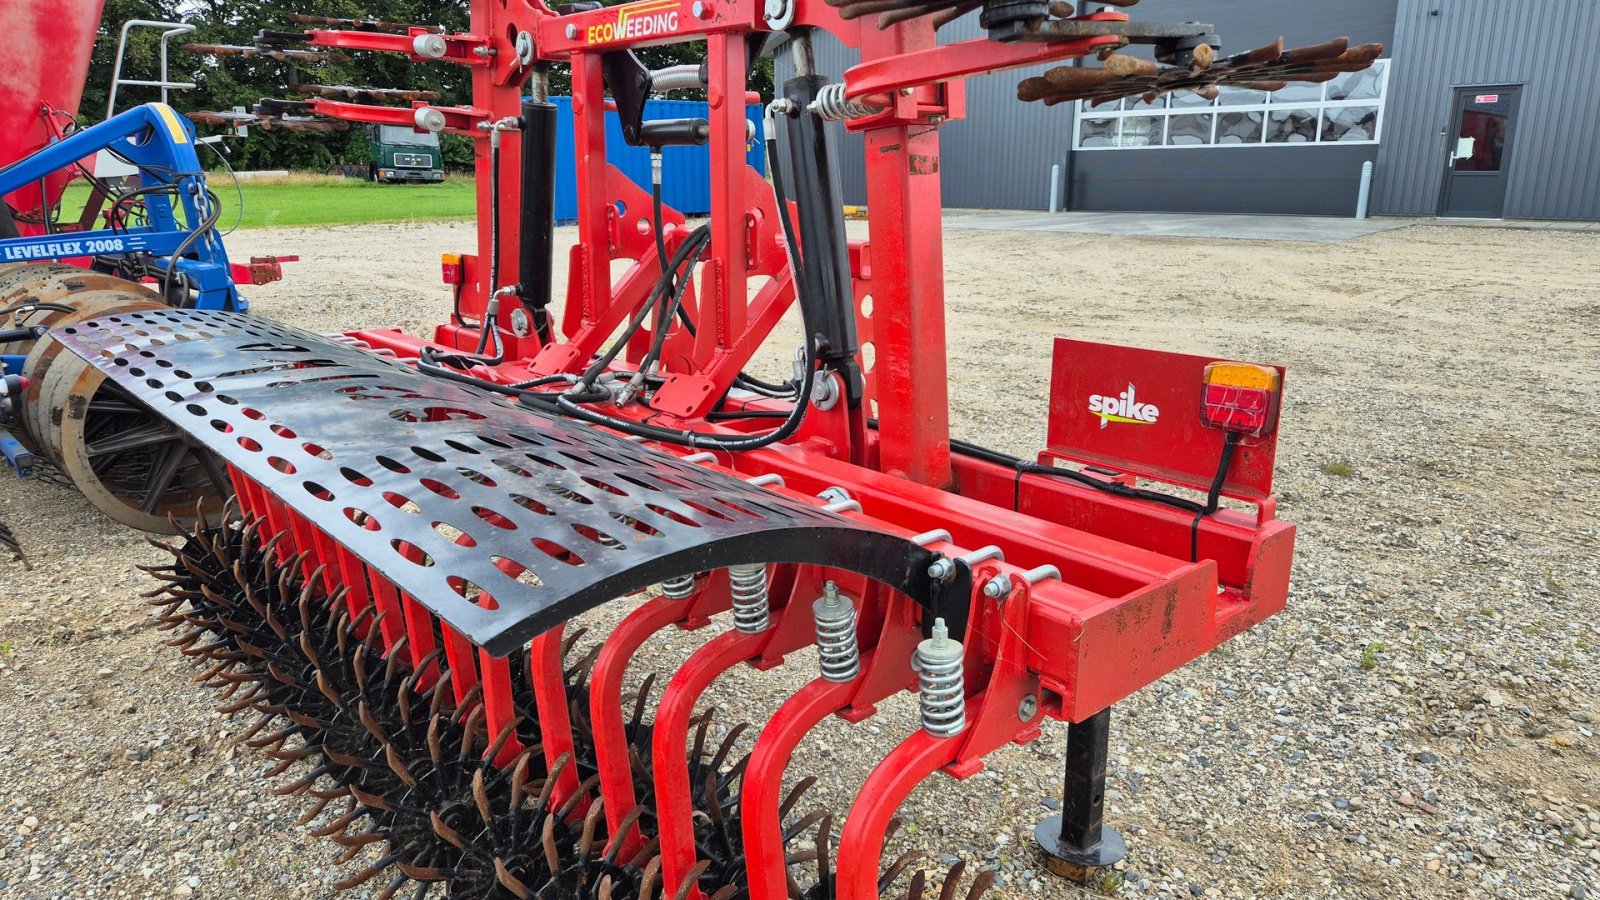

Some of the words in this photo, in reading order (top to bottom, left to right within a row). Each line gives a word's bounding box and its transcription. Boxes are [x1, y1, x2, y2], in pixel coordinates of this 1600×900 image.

[588, 10, 678, 44] ECOWEEDING
[4, 242, 83, 260] LEVELFLEX
[86, 239, 124, 253] 2008
[1088, 381, 1160, 429] spike
